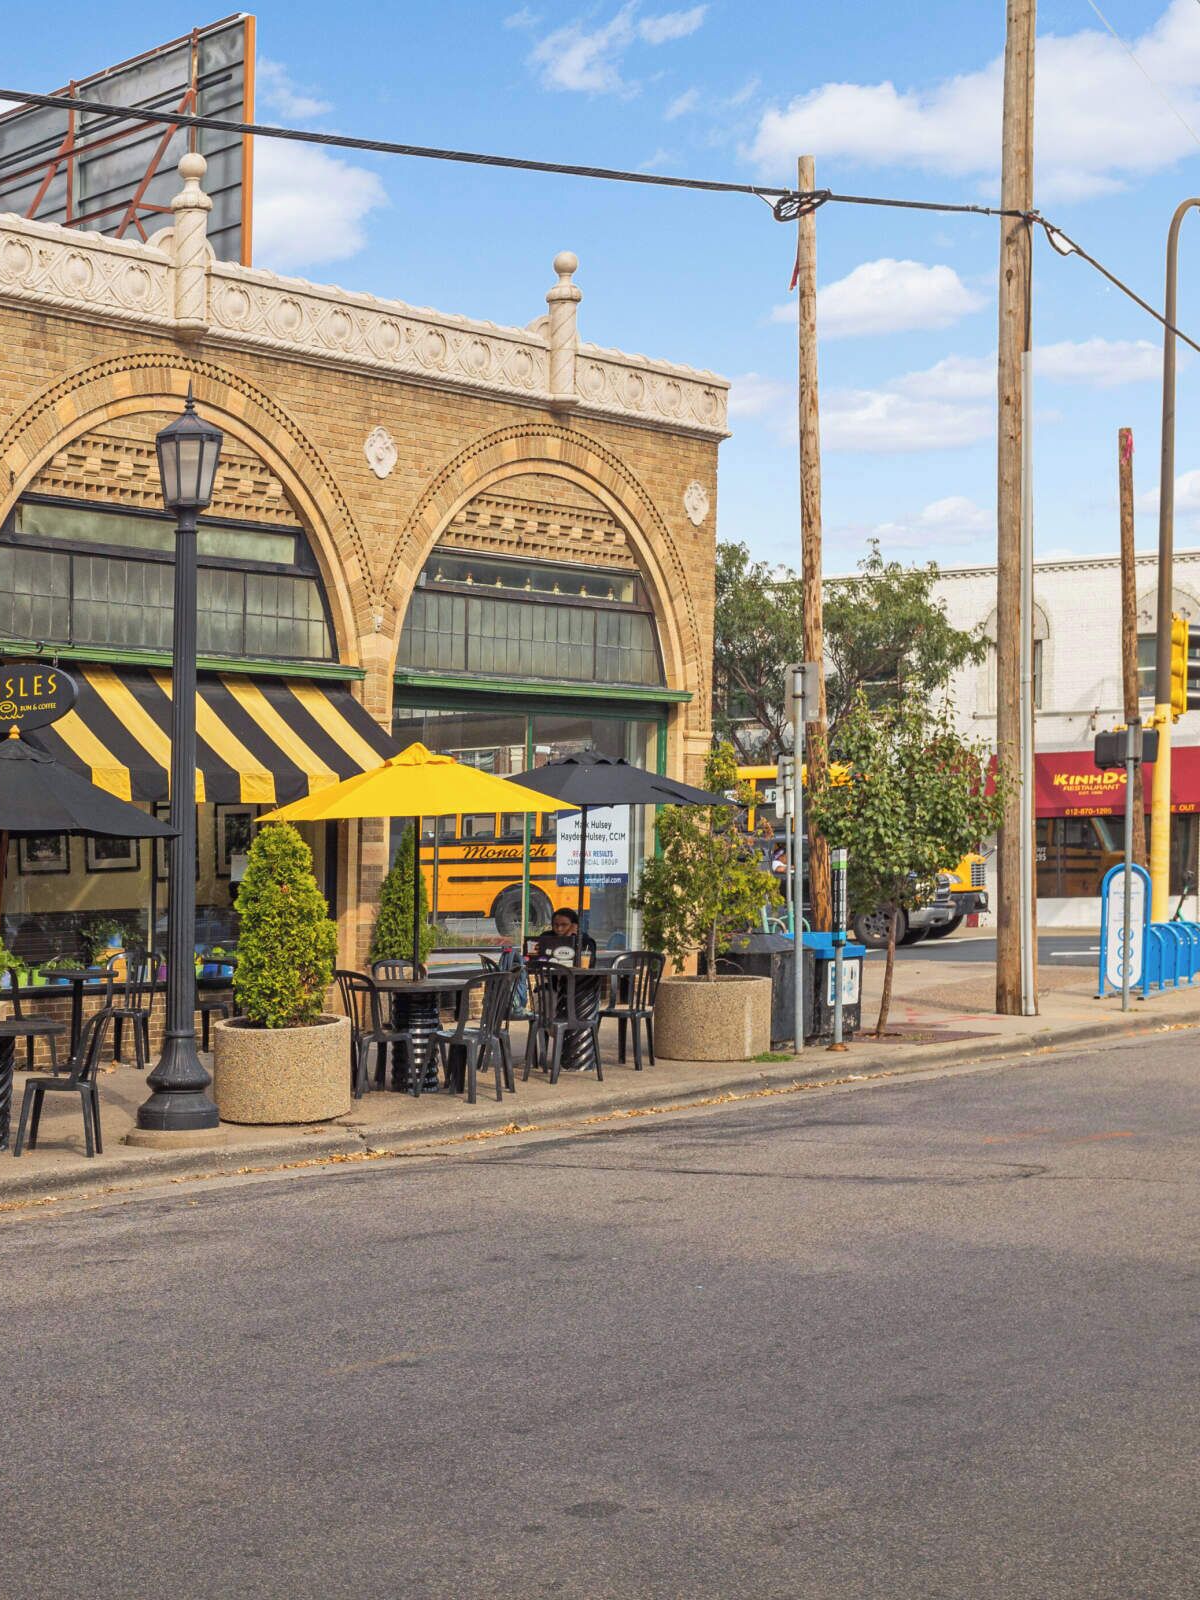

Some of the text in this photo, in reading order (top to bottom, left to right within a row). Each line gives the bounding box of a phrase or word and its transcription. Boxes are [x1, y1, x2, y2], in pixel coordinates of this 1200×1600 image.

[38, 702, 57, 710] COFFEE
[1063, 783, 1121, 791] RESTAURANT
[590, 820, 612, 830] Hulsey
[560, 832, 582, 842] Hayde
[608, 832, 626, 841] CCIM
[463, 844, 549, 859] Monach
[592, 850, 614, 858] RESULTS
[600, 858, 619, 866] GROUP
